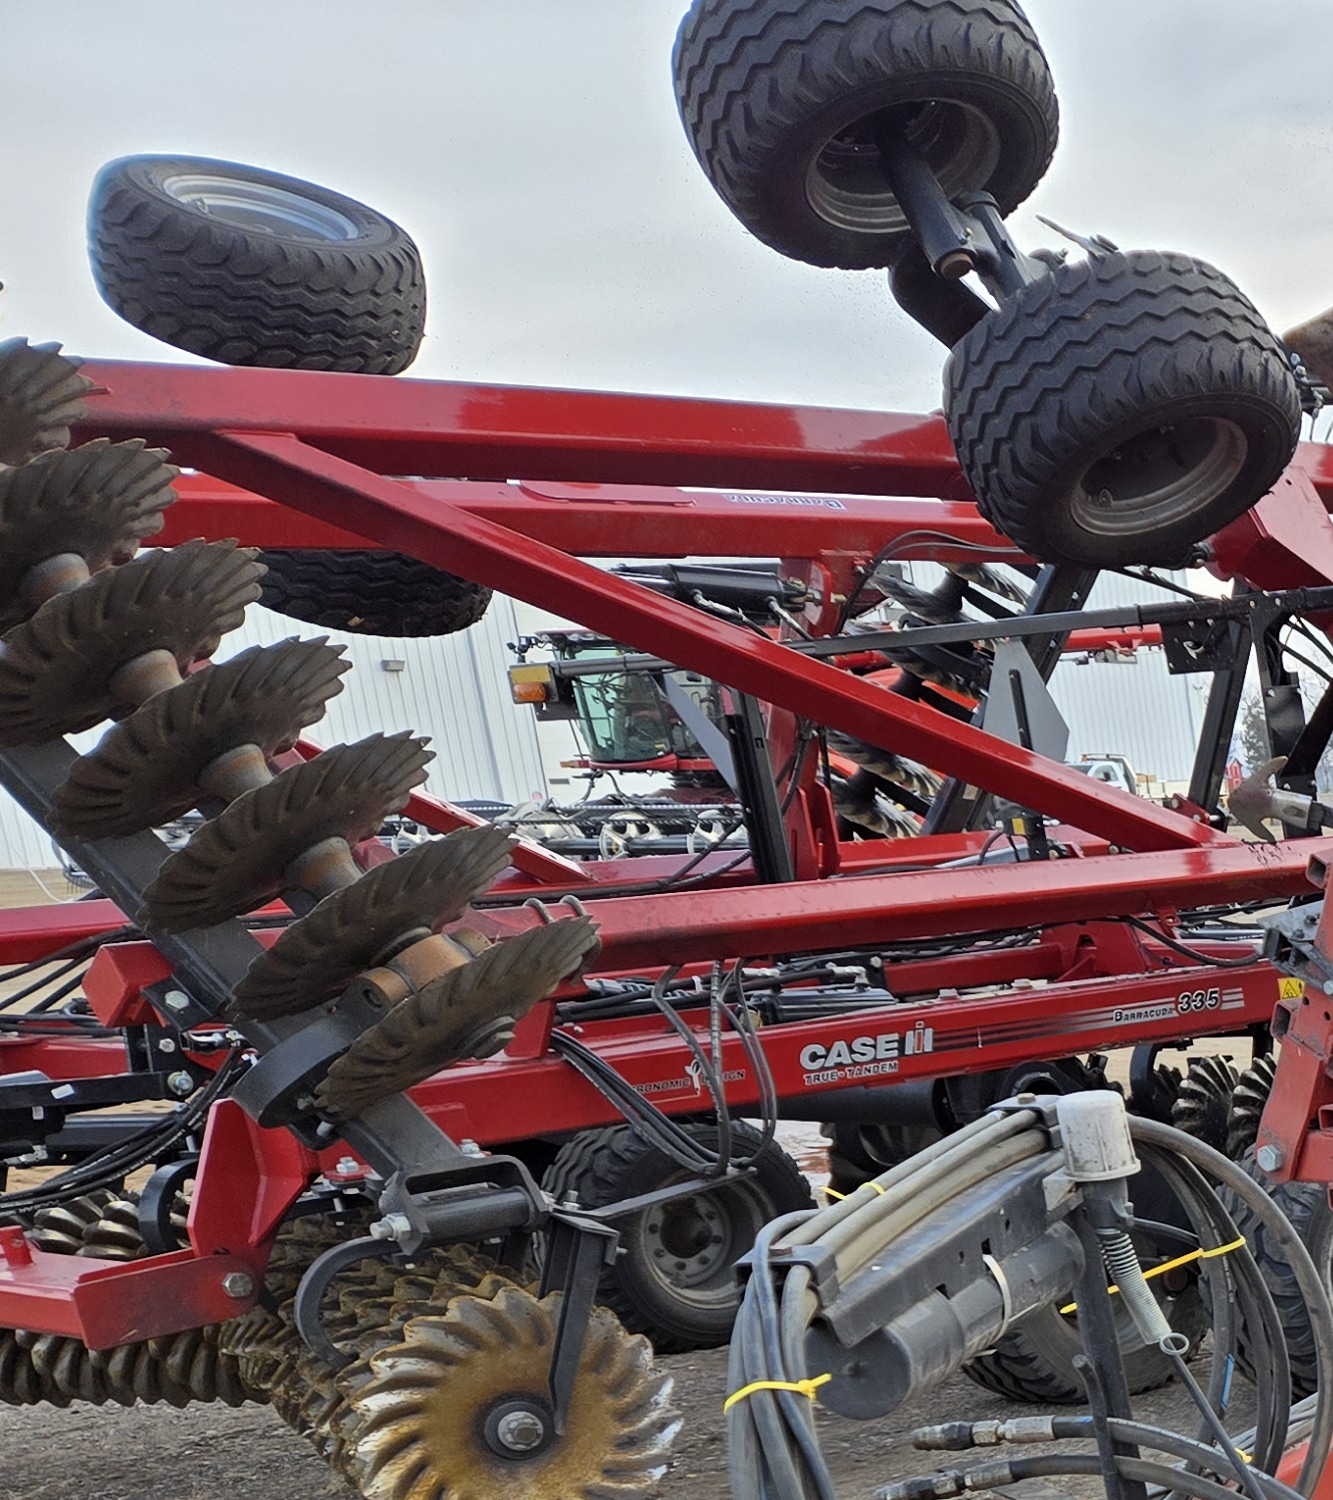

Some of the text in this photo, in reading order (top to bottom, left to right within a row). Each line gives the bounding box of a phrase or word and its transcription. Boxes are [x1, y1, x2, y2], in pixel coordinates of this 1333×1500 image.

[1178, 987, 1219, 1014] 335
[799, 1033, 899, 1070] CASE
[632, 1078, 690, 1095] RONOMIC
